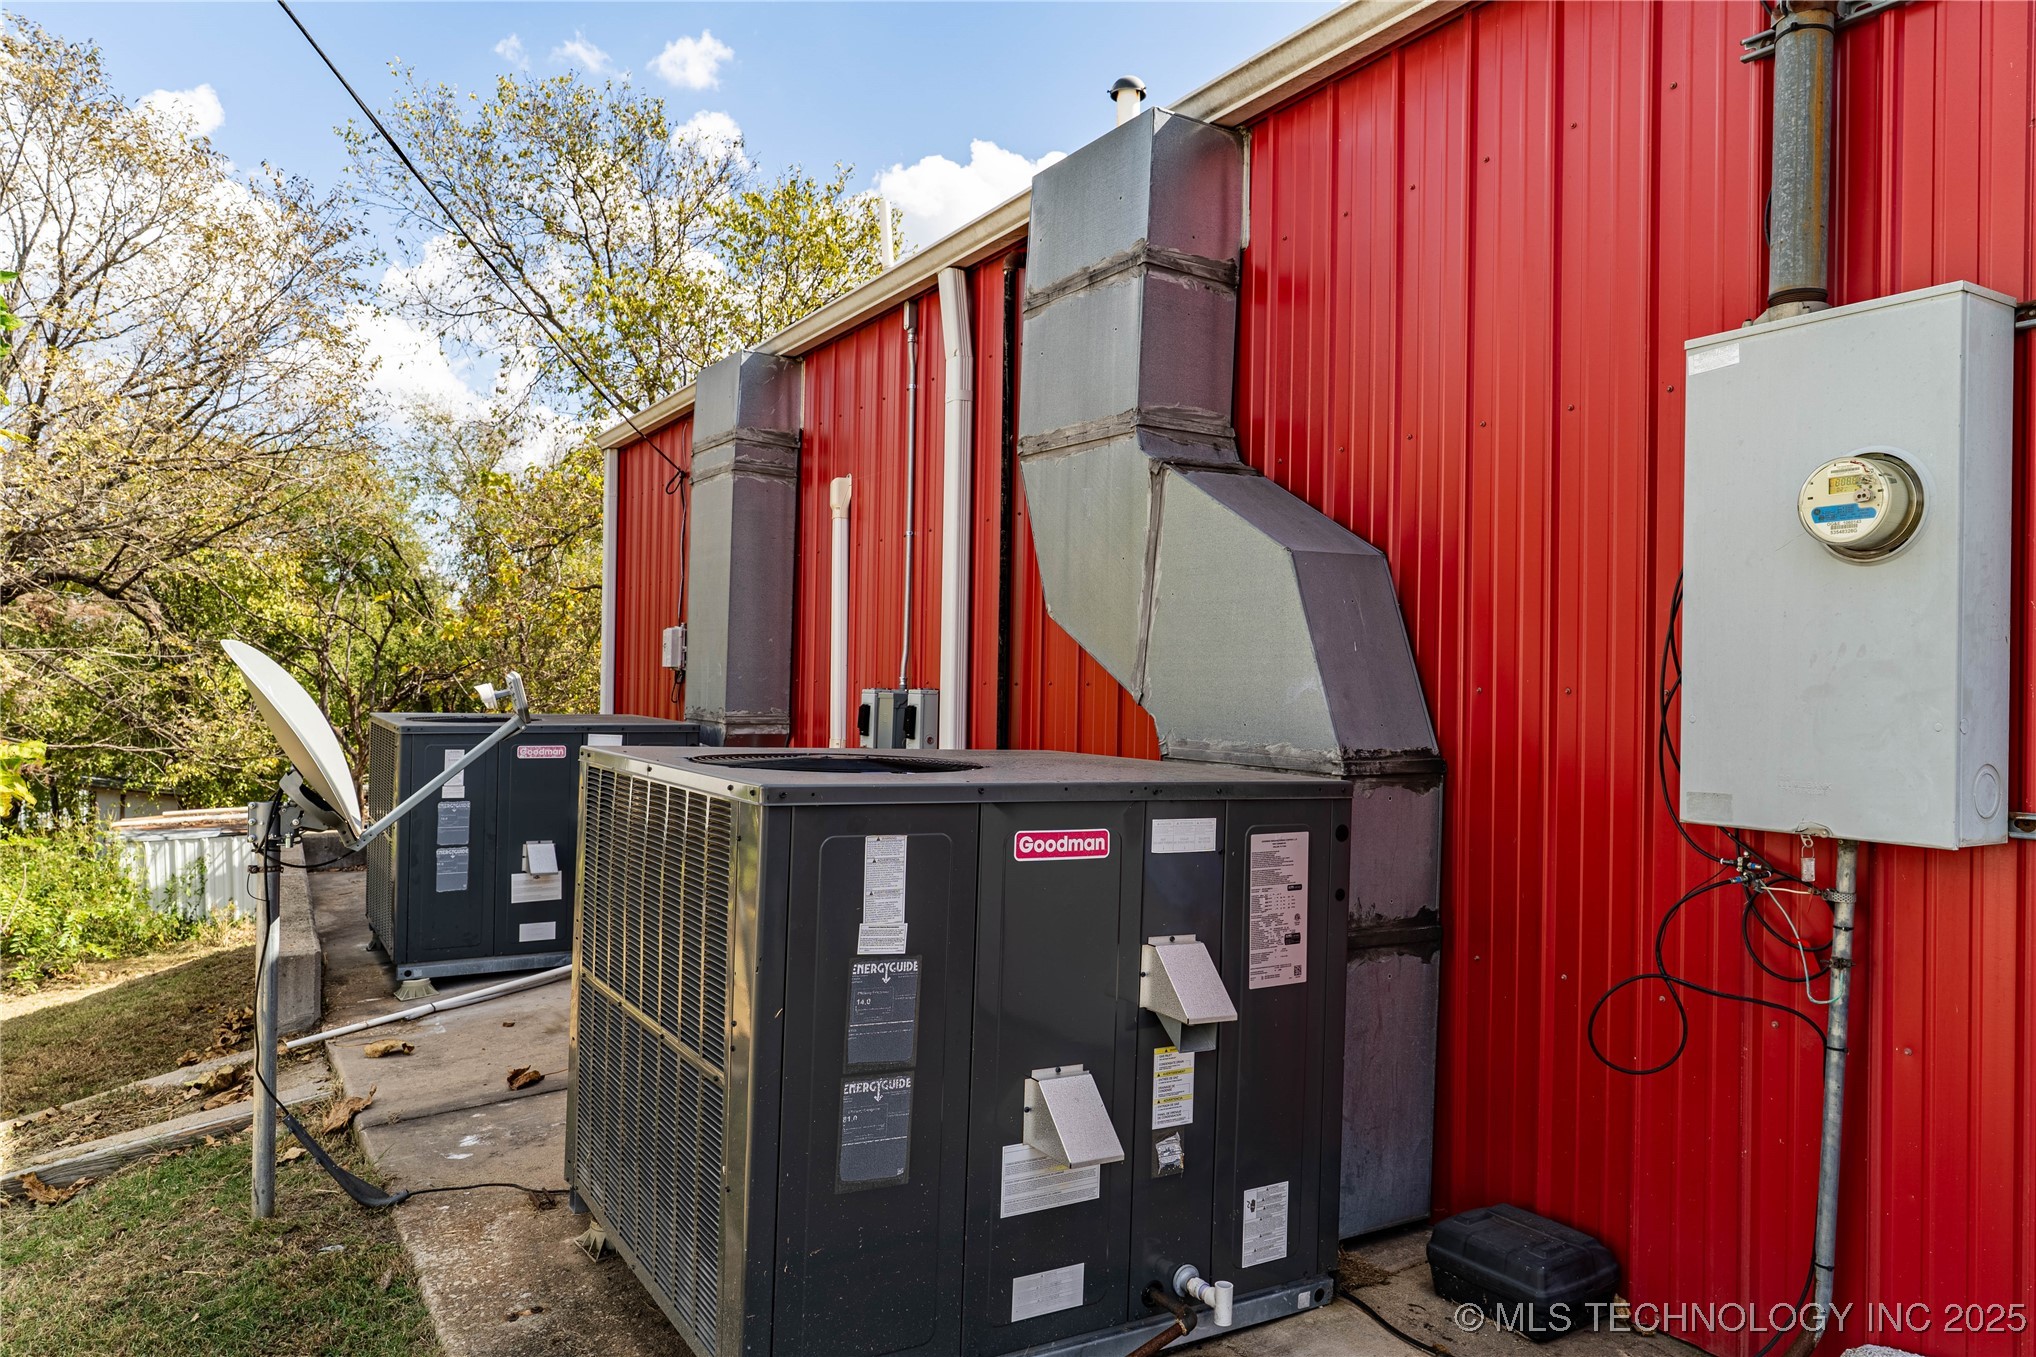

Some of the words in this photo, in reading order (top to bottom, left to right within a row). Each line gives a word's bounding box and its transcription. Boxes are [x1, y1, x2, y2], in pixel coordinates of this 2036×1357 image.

[520, 747, 564, 756] Goodman
[1019, 836, 1106, 854] Goodman
[852, 961, 918, 976] ENERGYGUIDE
[844, 1078, 912, 1095] ENERGYGUIDE
